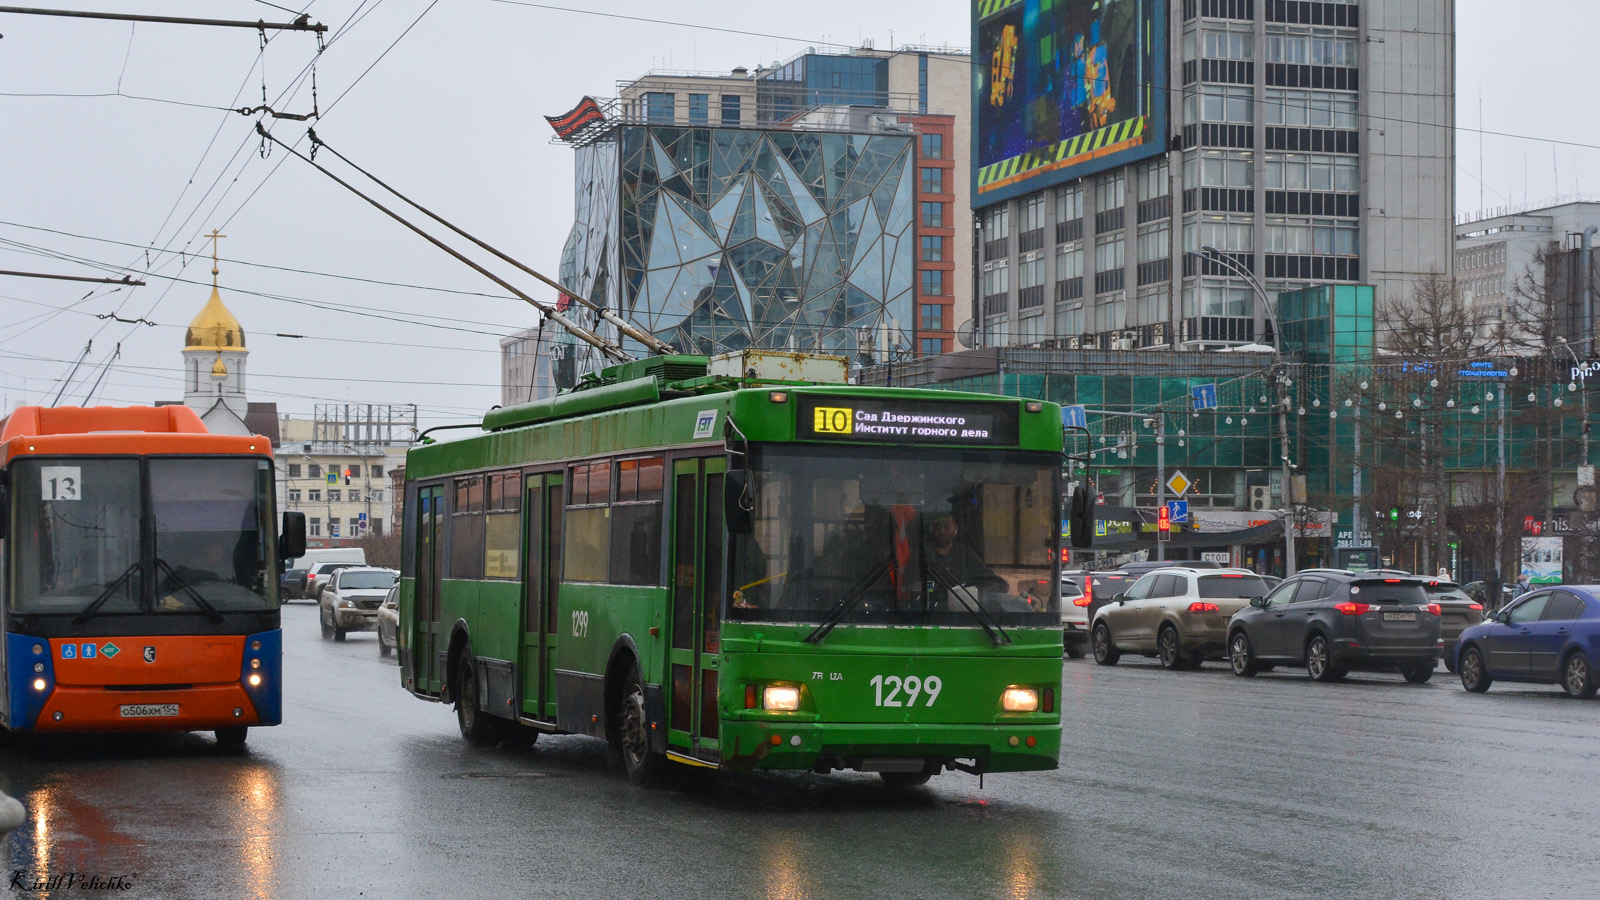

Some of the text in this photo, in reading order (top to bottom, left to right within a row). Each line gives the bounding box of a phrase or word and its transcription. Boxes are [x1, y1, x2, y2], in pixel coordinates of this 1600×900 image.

[818, 409, 849, 432] 10
[855, 410, 966, 426] Сад Дзержинского
[855, 422, 989, 438] Институт горного дела
[48, 477, 76, 499] 13
[1204, 553, 1228, 562] СТОП
[572, 611, 588, 637] 1299
[869, 674, 942, 708] 1299
